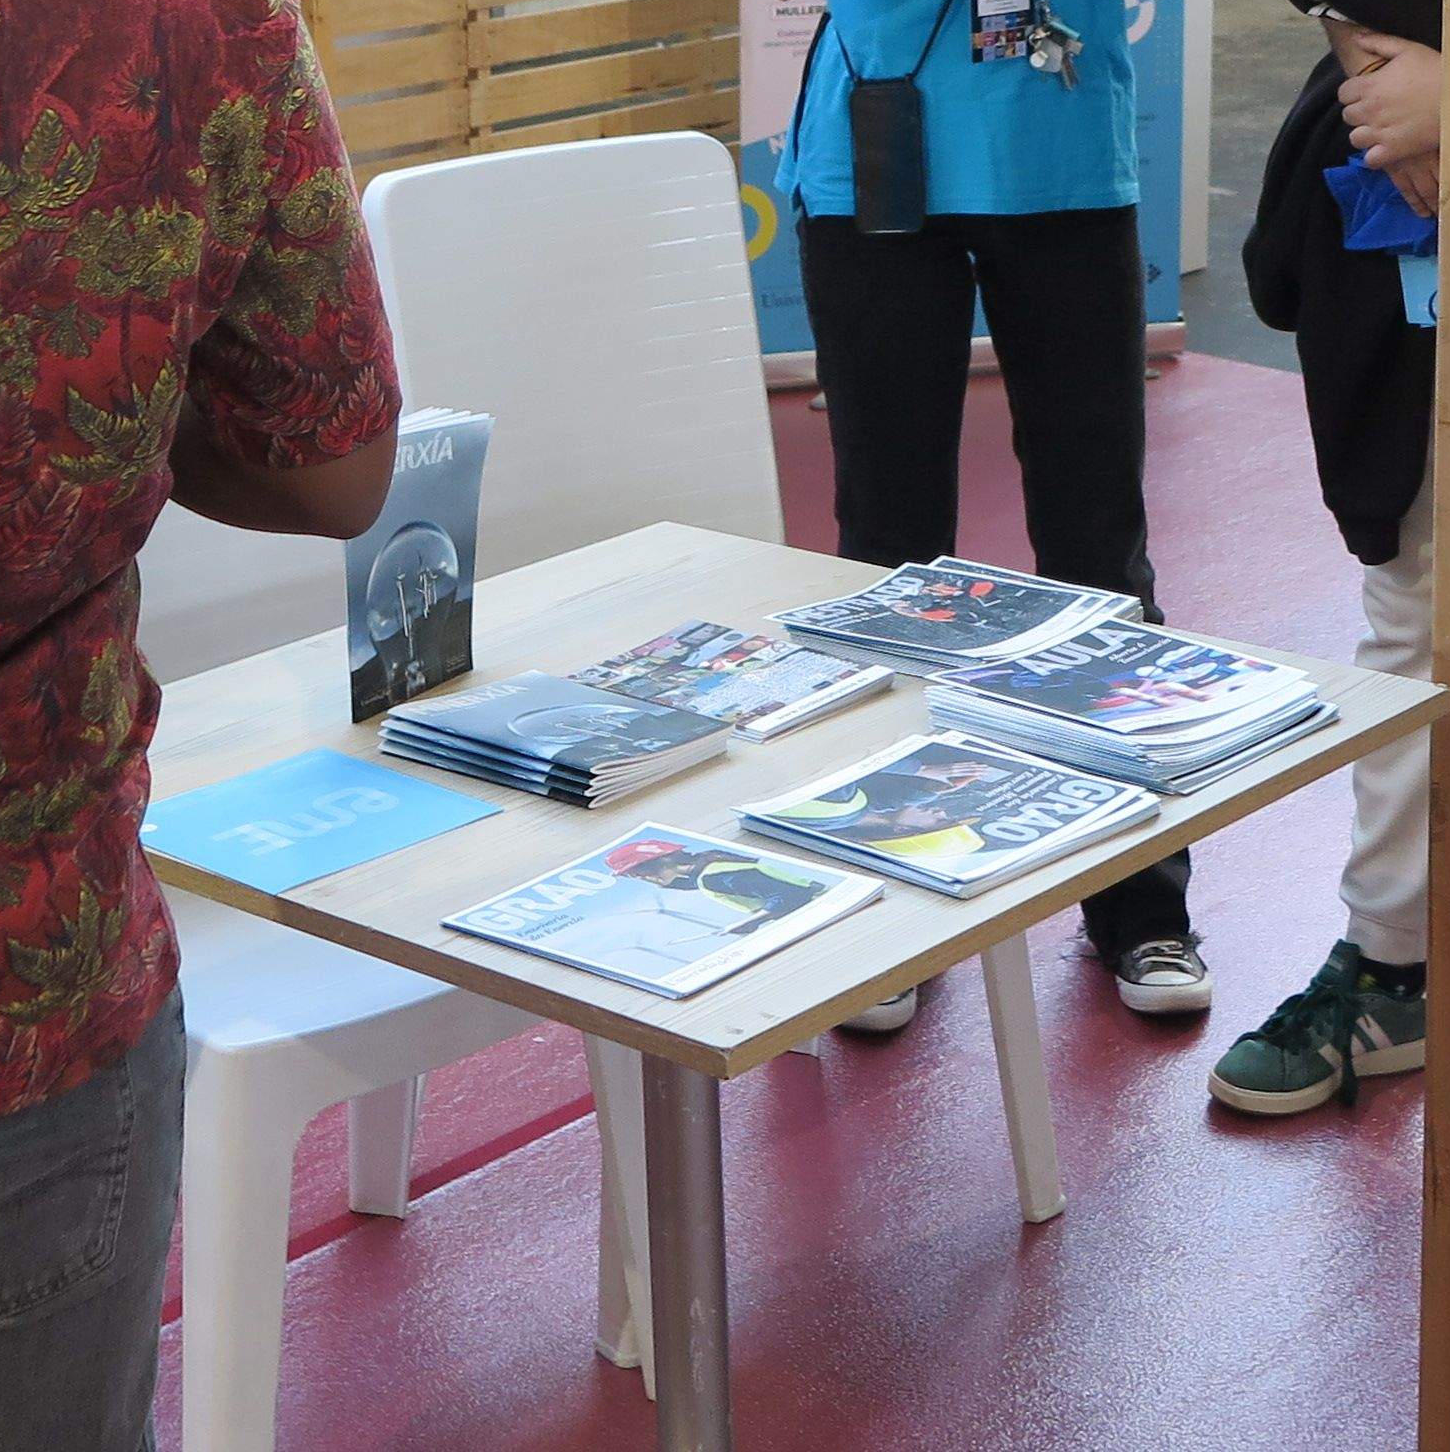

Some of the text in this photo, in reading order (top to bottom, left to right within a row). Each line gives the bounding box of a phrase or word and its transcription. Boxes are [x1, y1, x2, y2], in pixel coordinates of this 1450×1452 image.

[1015, 627, 1149, 677] AULA
[981, 779, 1117, 842] GRAO
[466, 868, 617, 932] GRAO
